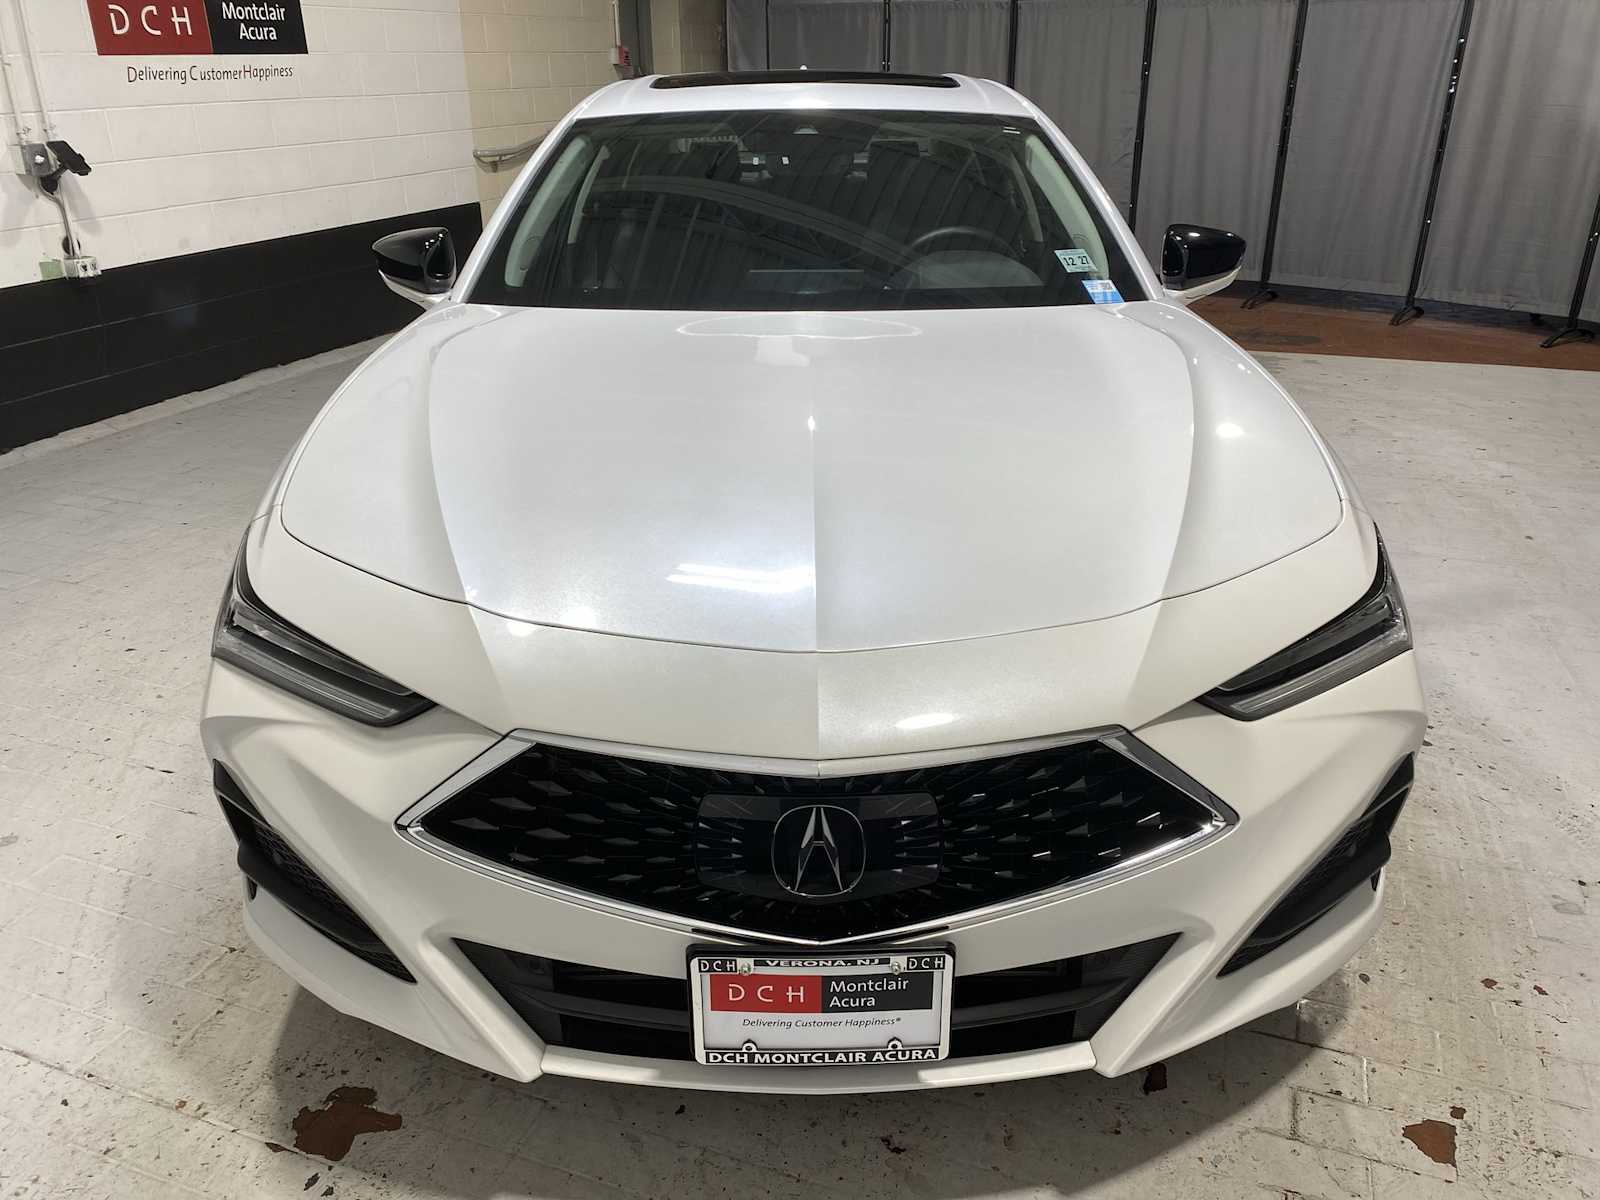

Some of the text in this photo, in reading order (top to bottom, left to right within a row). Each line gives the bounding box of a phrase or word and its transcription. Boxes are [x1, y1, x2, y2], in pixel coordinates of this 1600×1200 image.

[221, 1, 286, 21] Montclair
[107, 4, 193, 36] DCH
[239, 23, 278, 41] Acura
[127, 64, 293, 84] Delivering Customer Happiness
[700, 960, 736, 971] DCH
[909, 957, 944, 969] DCH
[829, 977, 909, 992] Montclair
[728, 984, 804, 1002] DCH
[829, 996, 876, 1008] Acura
[742, 1018, 792, 1029] Delivering
[795, 1018, 842, 1028] Customer
[708, 1049, 936, 1063] DCH MONTCLAIR ACURA
